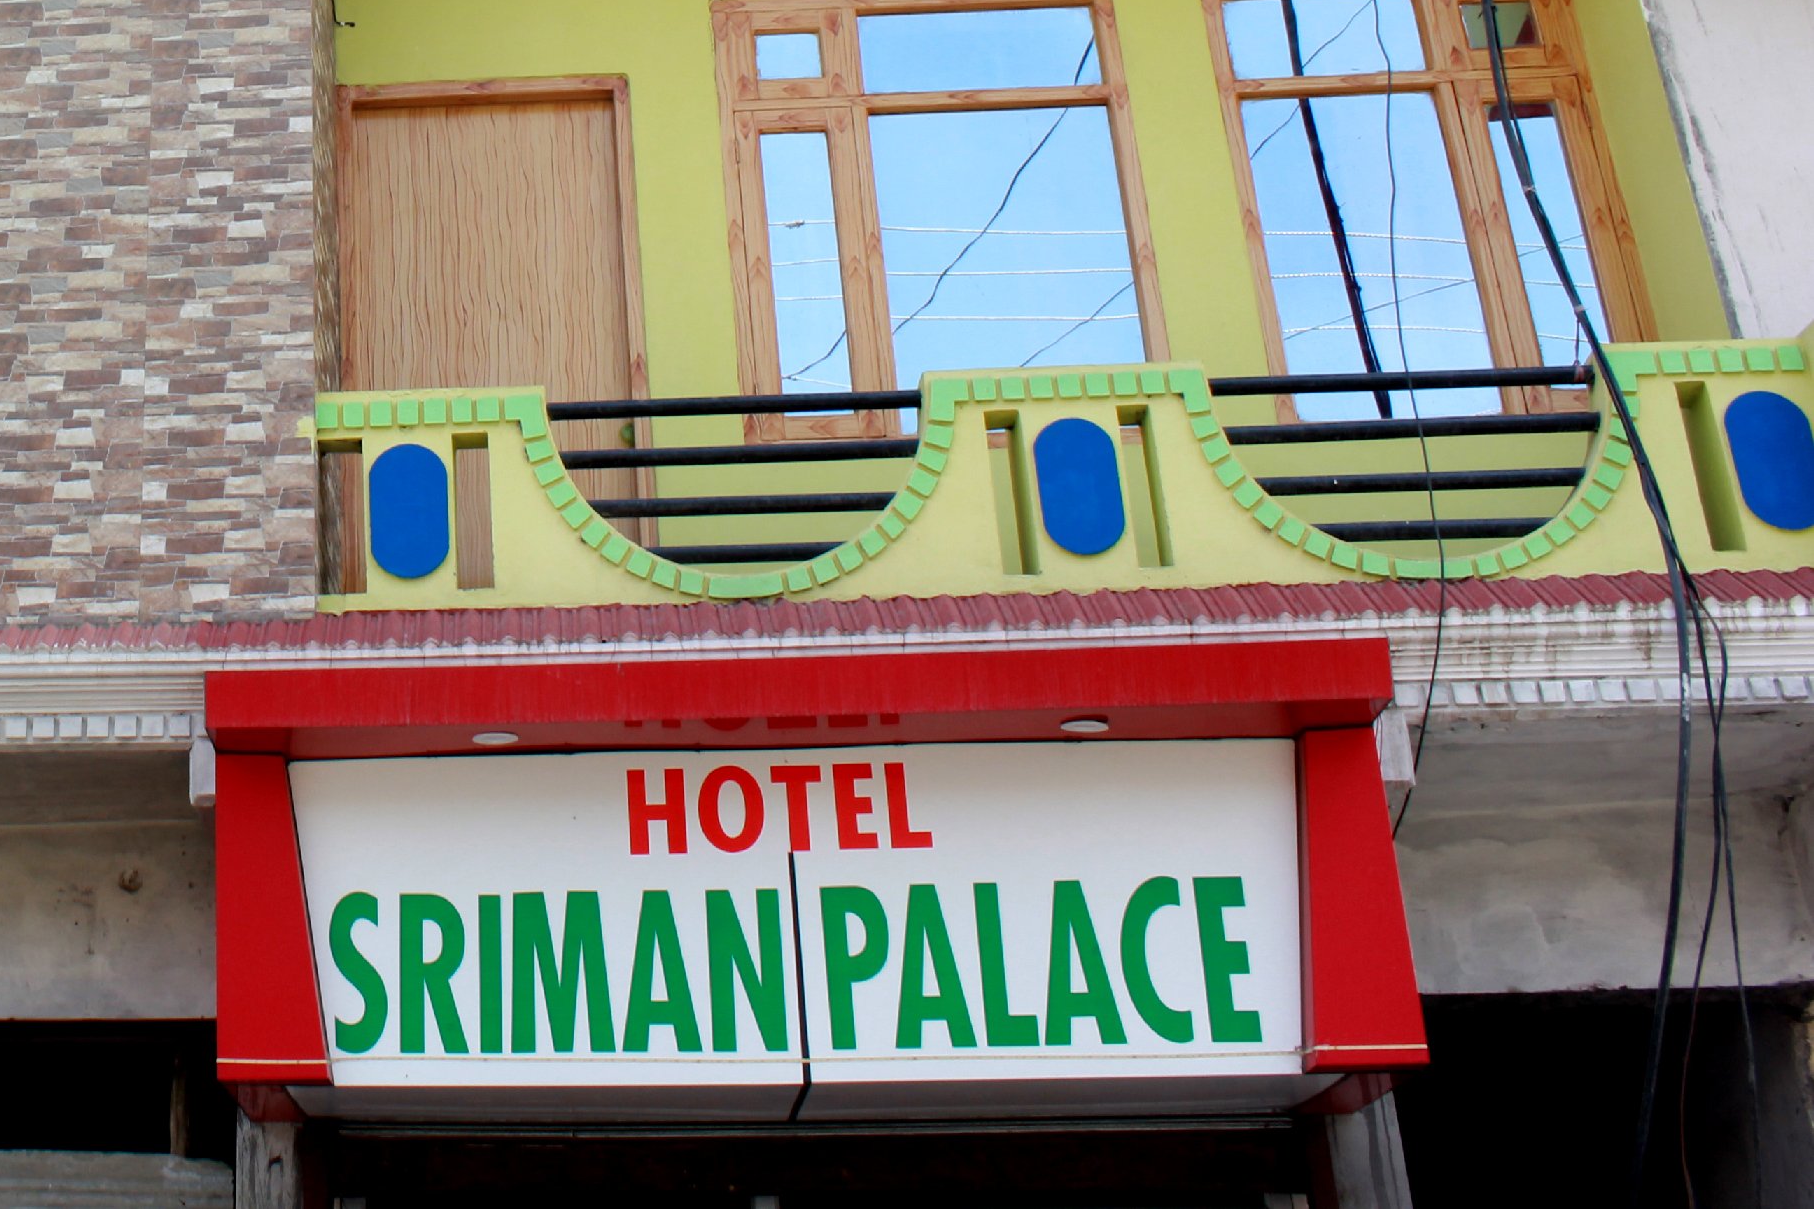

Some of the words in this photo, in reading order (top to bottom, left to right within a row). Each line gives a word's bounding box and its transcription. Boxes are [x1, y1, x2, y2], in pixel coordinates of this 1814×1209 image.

[625, 761, 934, 856] HOTEL
[328, 888, 790, 1055] SRIMAN
[819, 875, 1264, 1051] PALACE
